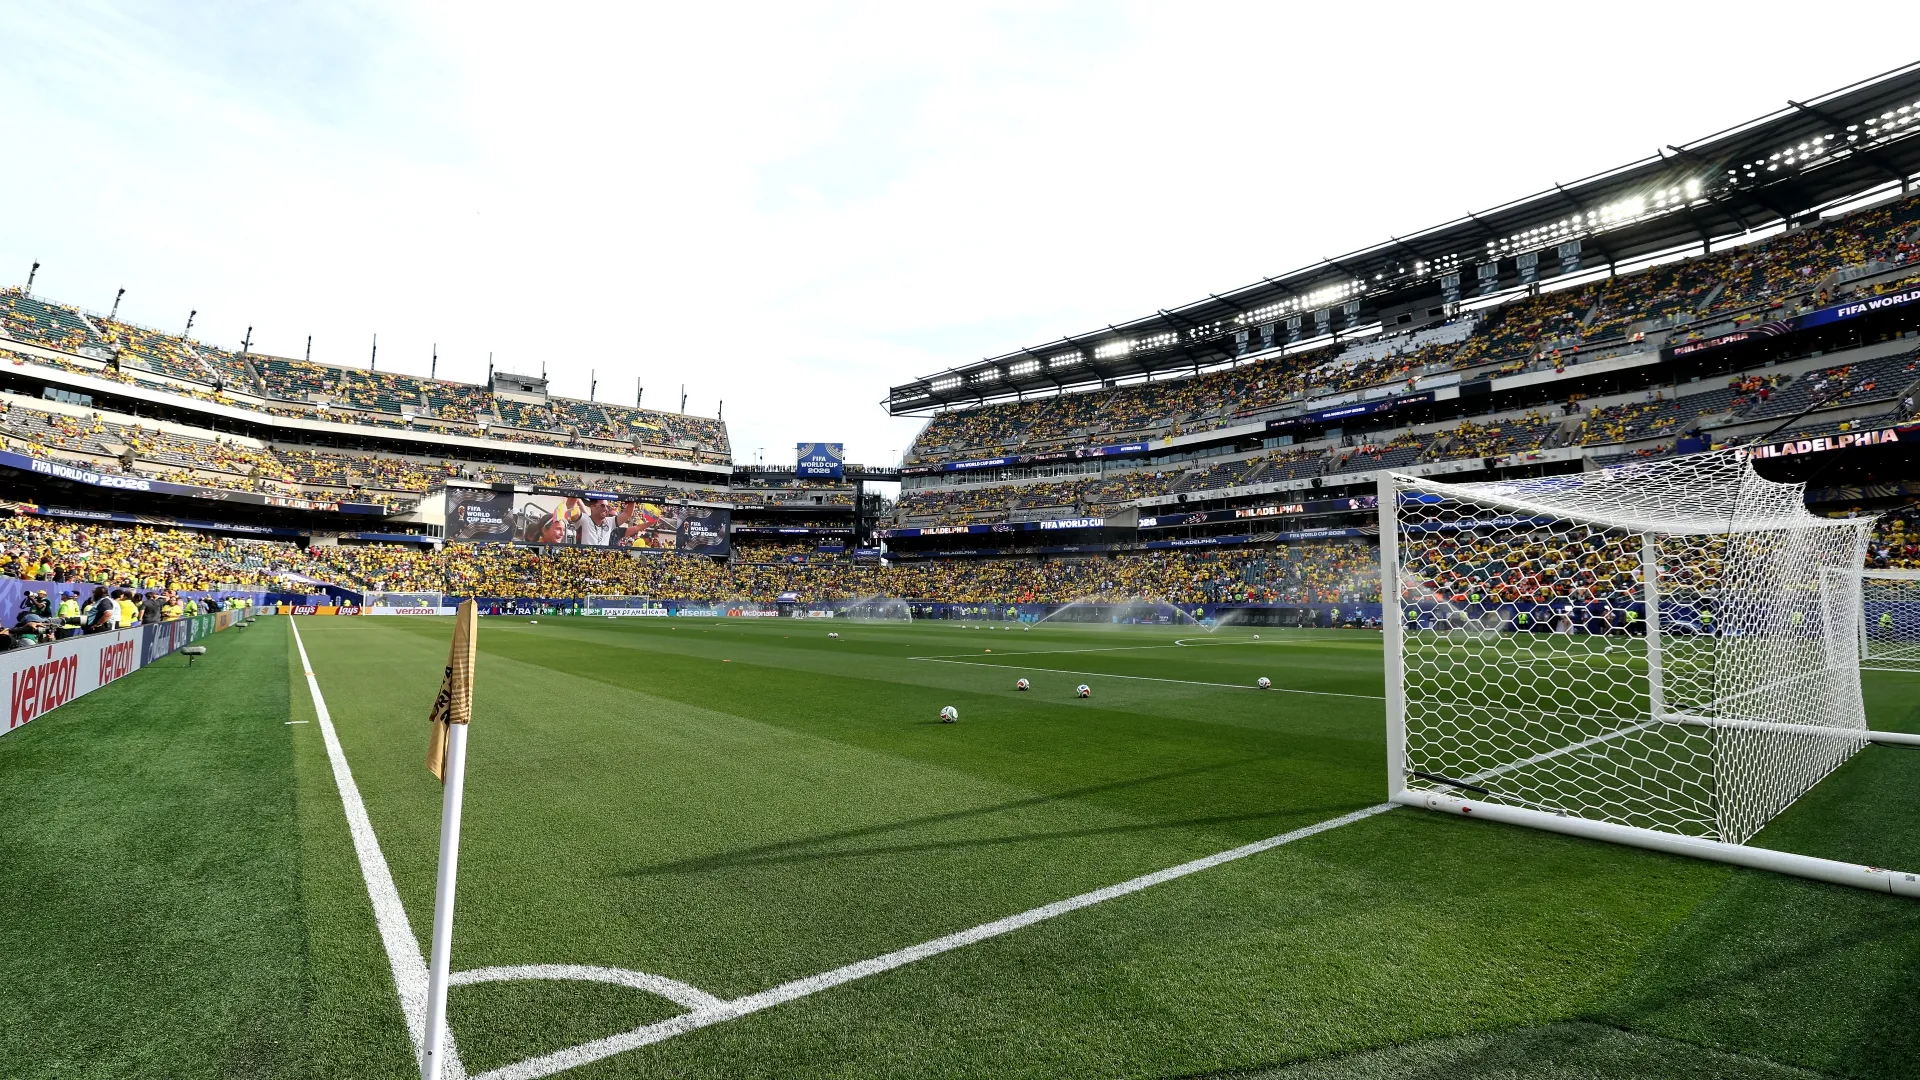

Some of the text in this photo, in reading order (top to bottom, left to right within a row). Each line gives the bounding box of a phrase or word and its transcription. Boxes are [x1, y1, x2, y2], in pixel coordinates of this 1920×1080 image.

[1838, 291, 1920, 317] FIFA WORLD
[1674, 333, 1749, 355] PHILADELPHIA
[1735, 429, 1899, 462] PHILADELPHIA
[32, 459, 151, 491] FIFA WORLD CUP 2026
[264, 496, 340, 511] PHILADELPHIA
[1235, 503, 1304, 519] PHILADELPHIA
[48, 508, 73, 516] WORLD
[214, 522, 273, 534] PHILADELPHIA
[920, 526, 969, 536] PHILADELPHIA
[1040, 521, 1058, 530] FIFA
[1058, 519, 1088, 529] WORLD
[1171, 538, 1217, 546] PHILADELPHIA
[395, 606, 434, 615] verizon
[98, 632, 134, 687] verizon
[10, 645, 78, 729] verizon
